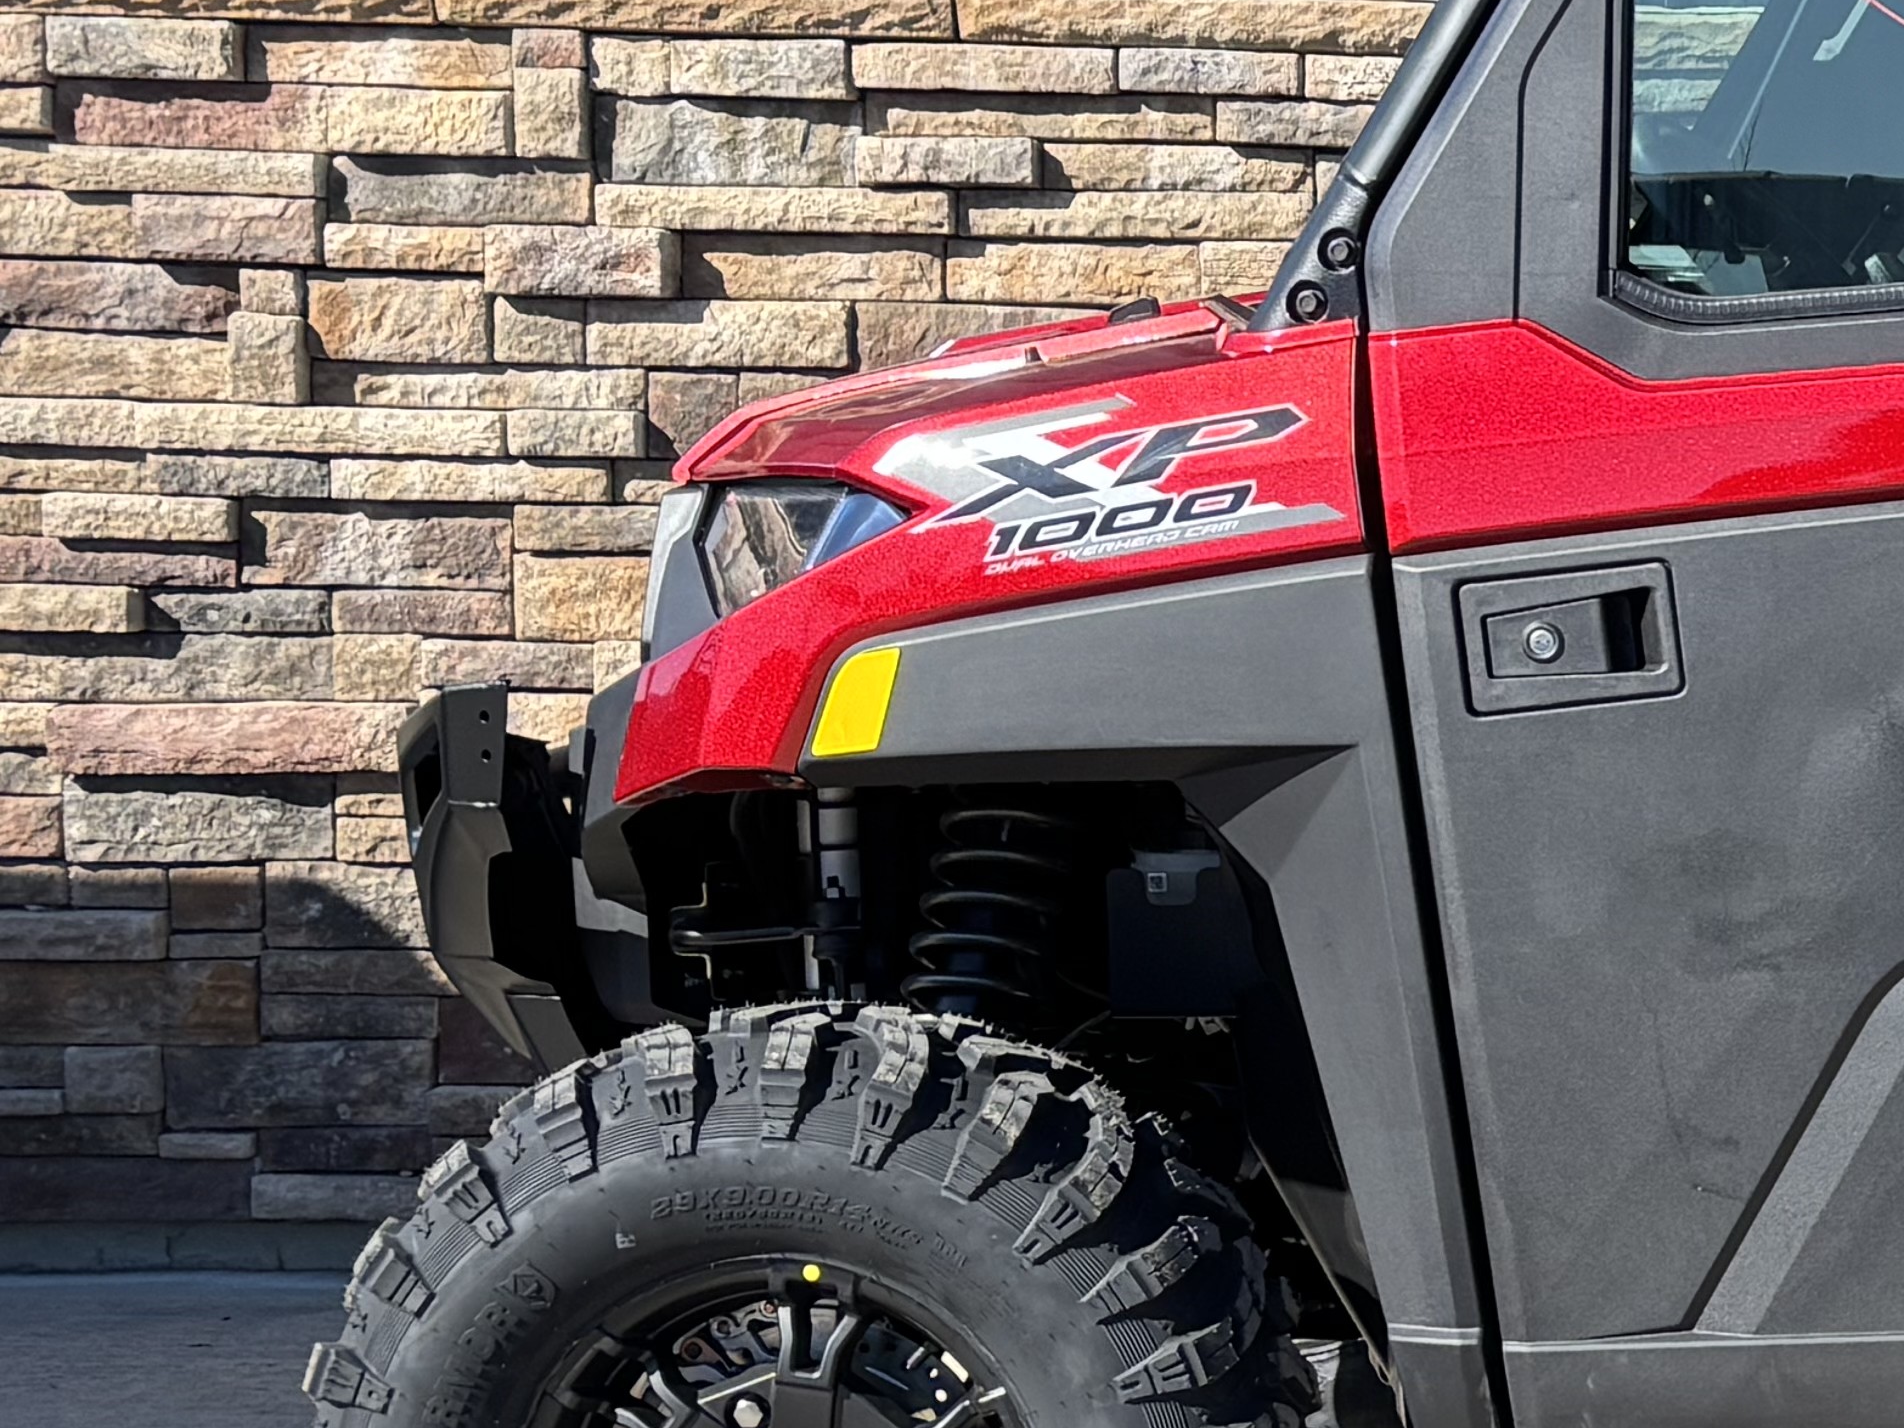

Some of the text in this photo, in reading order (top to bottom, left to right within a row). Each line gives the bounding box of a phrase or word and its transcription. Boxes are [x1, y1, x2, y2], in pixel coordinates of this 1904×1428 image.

[930, 406, 1305, 523] XP
[985, 519, 1240, 575] DUAL OVERHEAD CAM
[989, 482, 1254, 559] 1000
